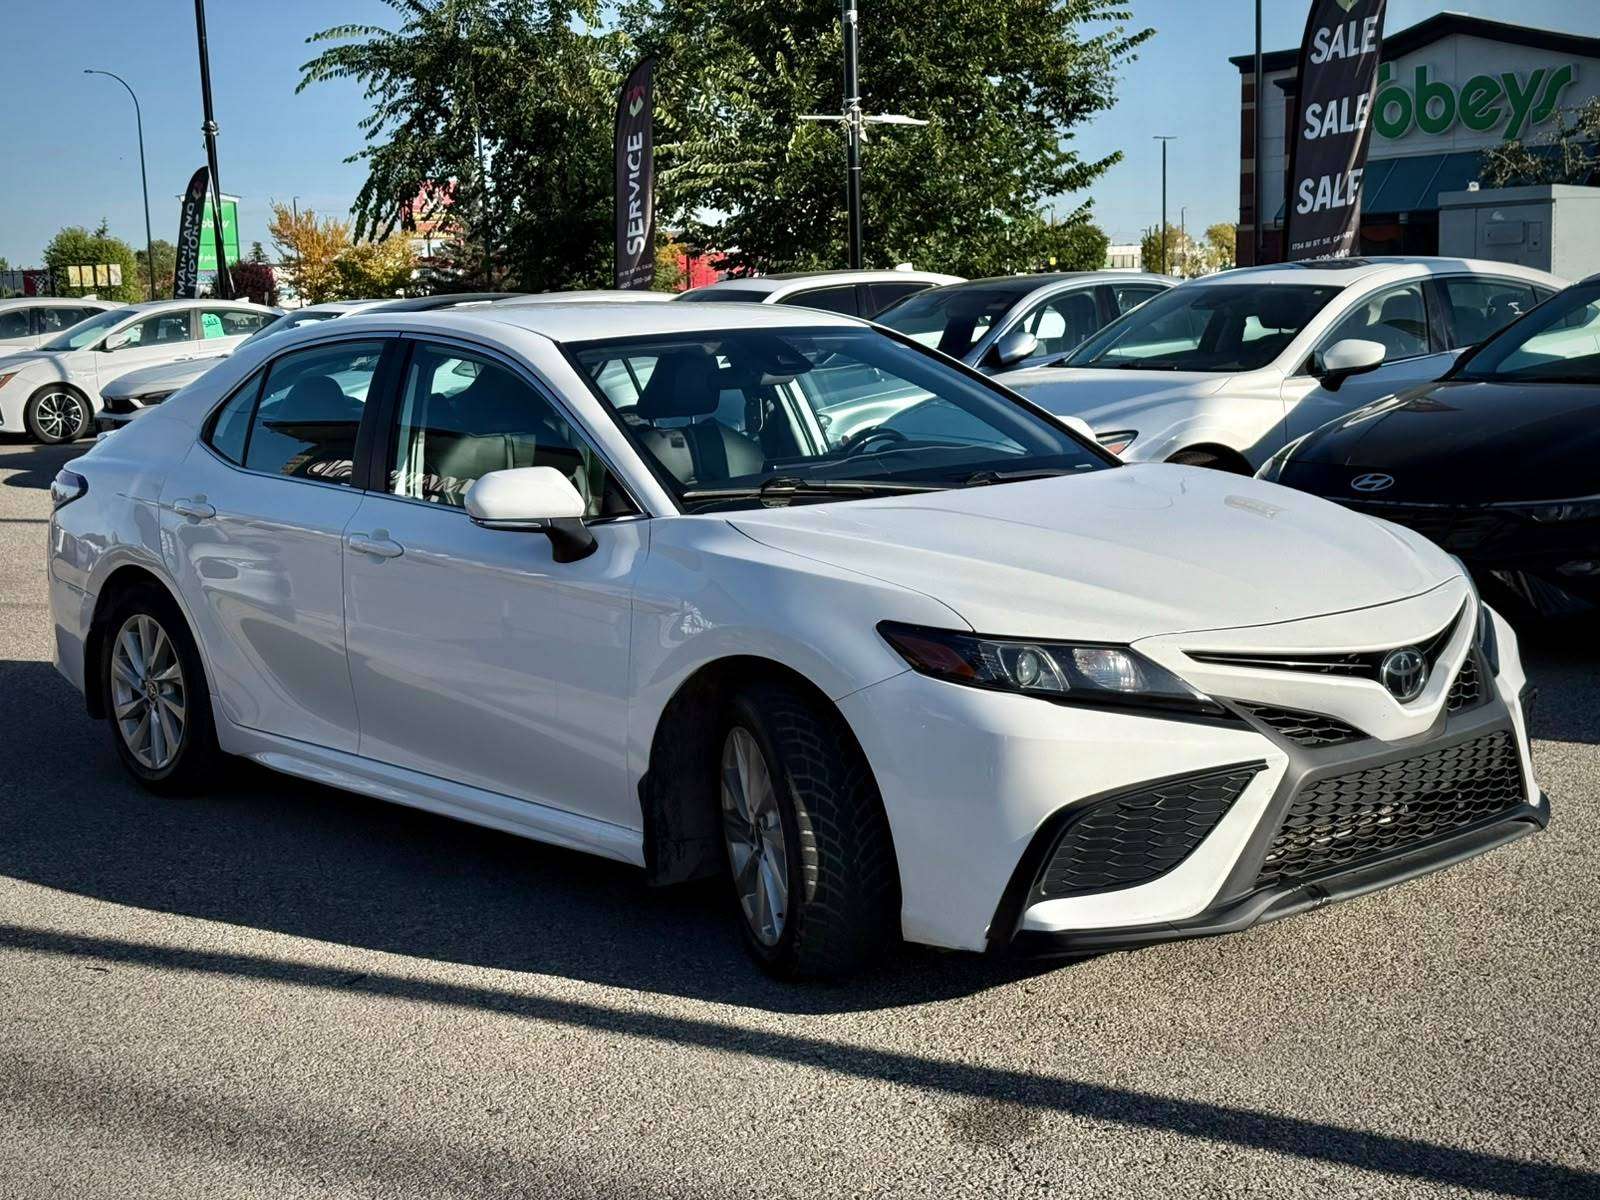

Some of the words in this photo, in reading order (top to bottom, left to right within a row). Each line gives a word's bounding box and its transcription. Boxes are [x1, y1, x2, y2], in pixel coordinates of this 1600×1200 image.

[1310, 15, 1378, 65] SALE
[1304, 93, 1370, 140] SALE
[1373, 64, 1572, 140] obeys
[627, 132, 645, 255] SERVICE
[1296, 168, 1363, 215] SALE
